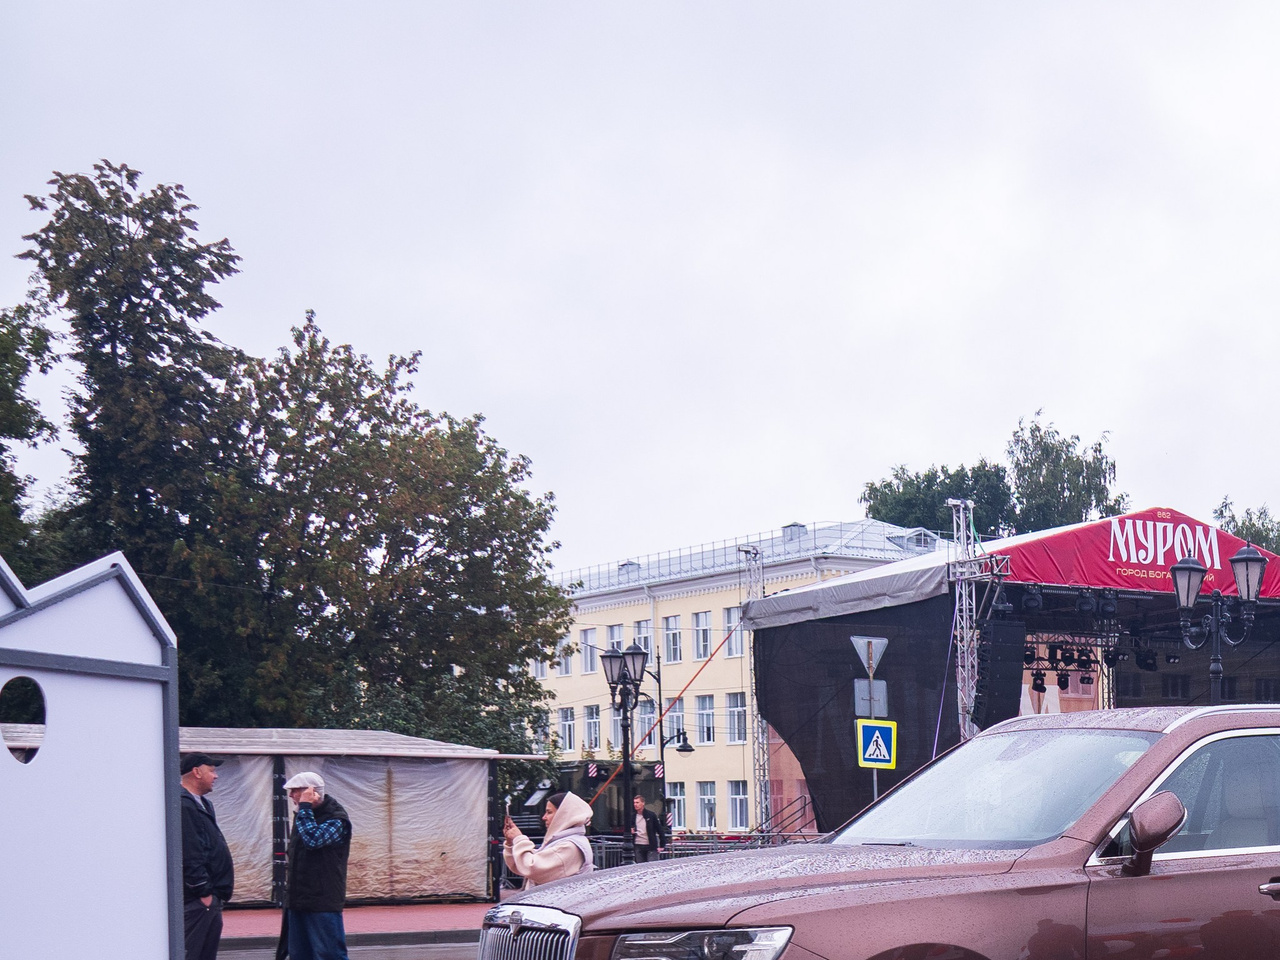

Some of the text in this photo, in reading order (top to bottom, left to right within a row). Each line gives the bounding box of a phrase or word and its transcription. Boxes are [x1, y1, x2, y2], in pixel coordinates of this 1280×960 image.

[1156, 511, 1171, 519] 862
[1107, 518, 1222, 570] МУРОМ
[1116, 568, 1148, 578] ГОРОД
